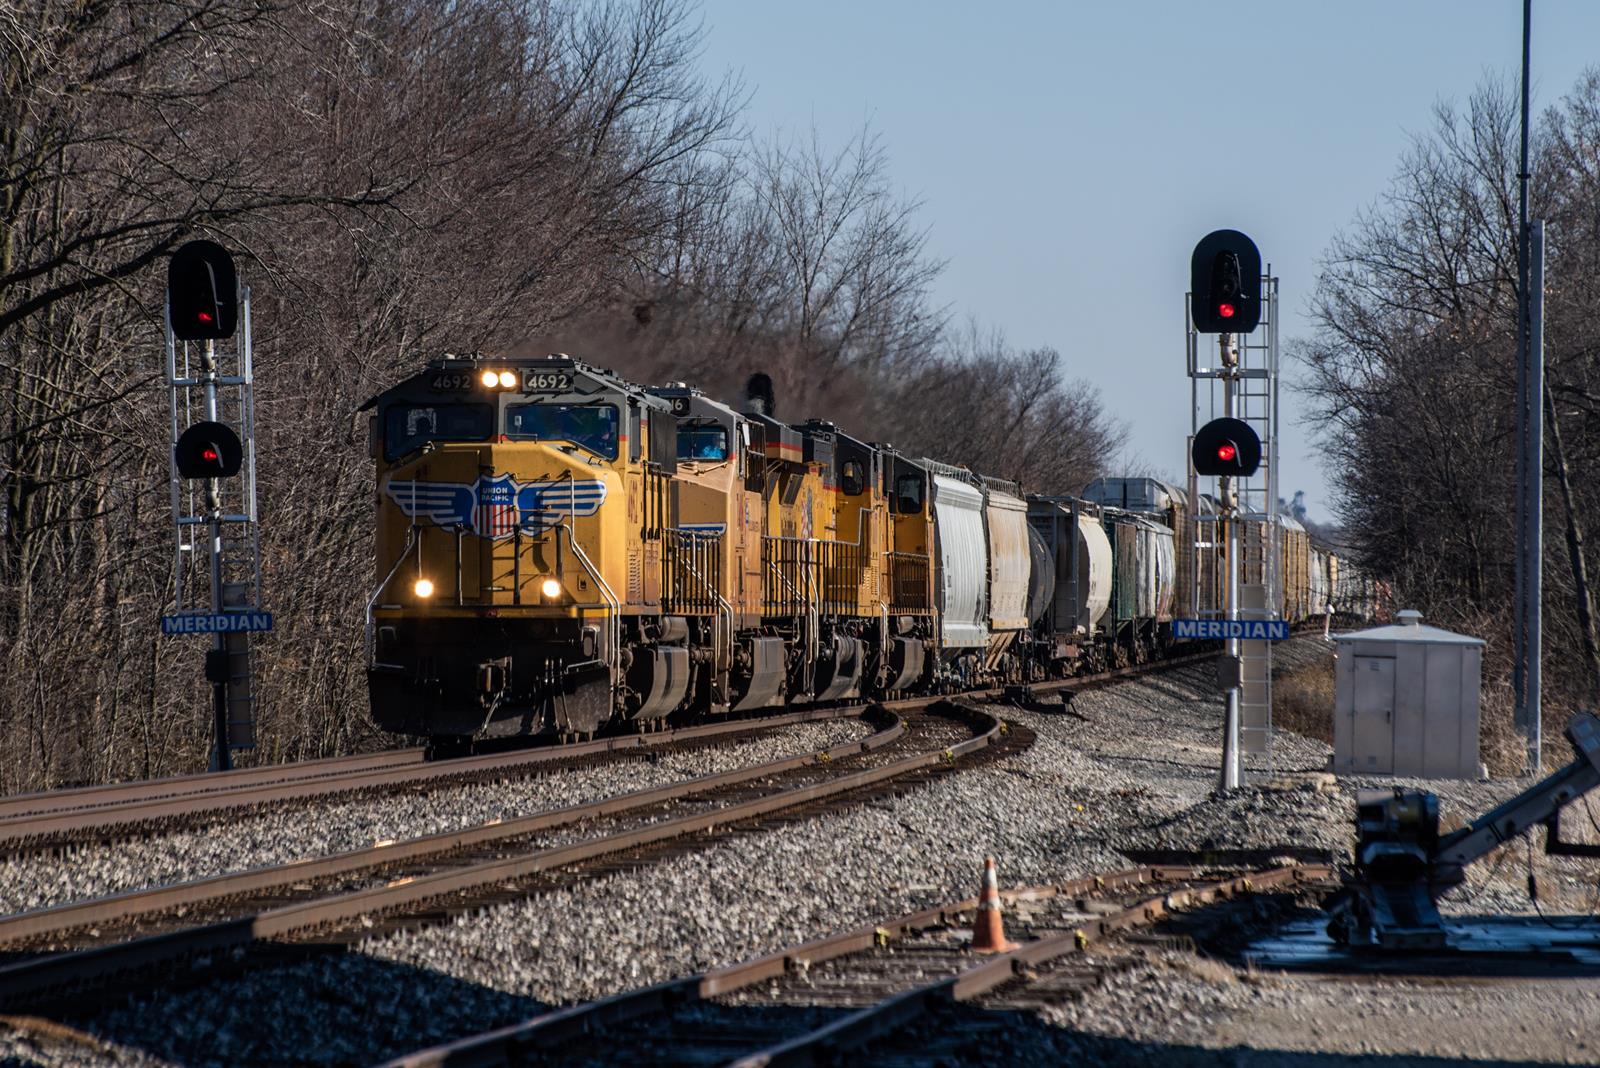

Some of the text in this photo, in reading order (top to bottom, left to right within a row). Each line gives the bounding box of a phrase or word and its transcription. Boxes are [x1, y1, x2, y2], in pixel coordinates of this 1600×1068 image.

[433, 375, 470, 388] 4692
[528, 375, 567, 388] 4692
[482, 494, 509, 502] PACIFIC
[165, 615, 268, 632] MERIDIAN
[1177, 621, 1283, 638] MERIDIAN
